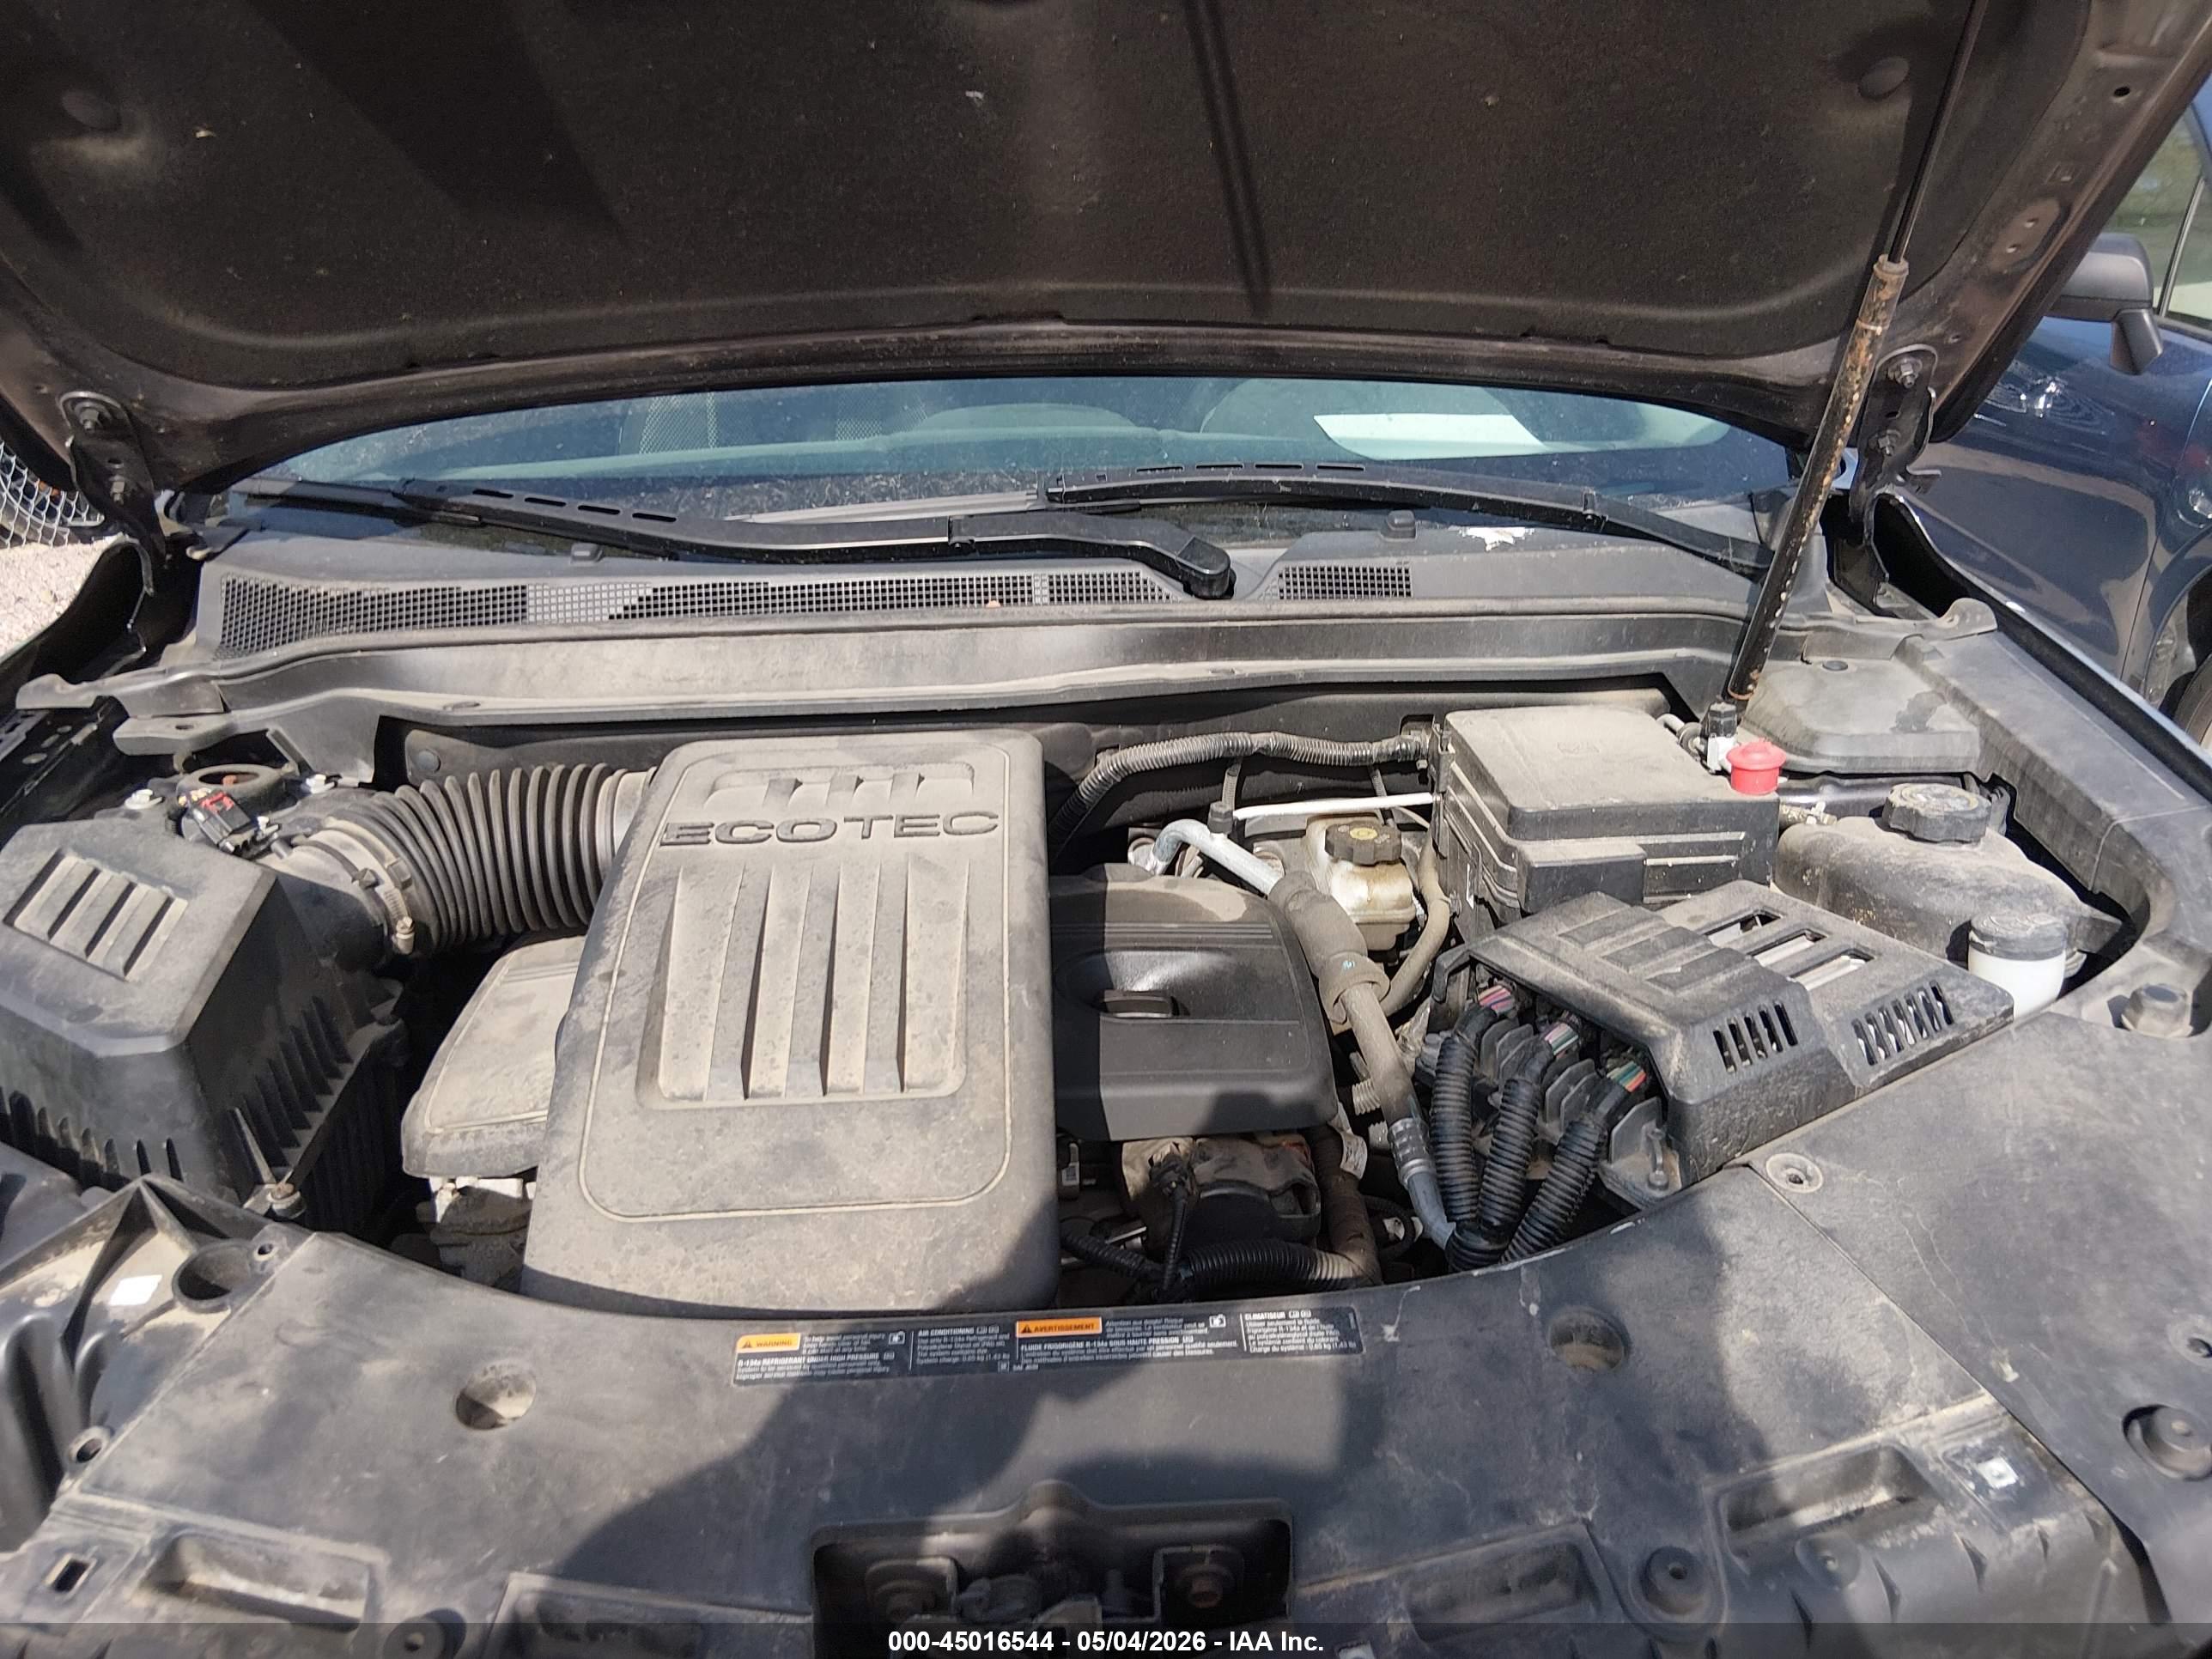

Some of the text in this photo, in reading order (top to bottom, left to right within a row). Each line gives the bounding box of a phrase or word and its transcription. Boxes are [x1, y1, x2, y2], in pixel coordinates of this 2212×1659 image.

[659, 810, 999, 847] ECOTEC
[1034, 1323, 1095, 1333] AVERTISSEMENT
[756, 1339, 792, 1347] WARNING
[1148, 1335, 1180, 1345] PRESSION
